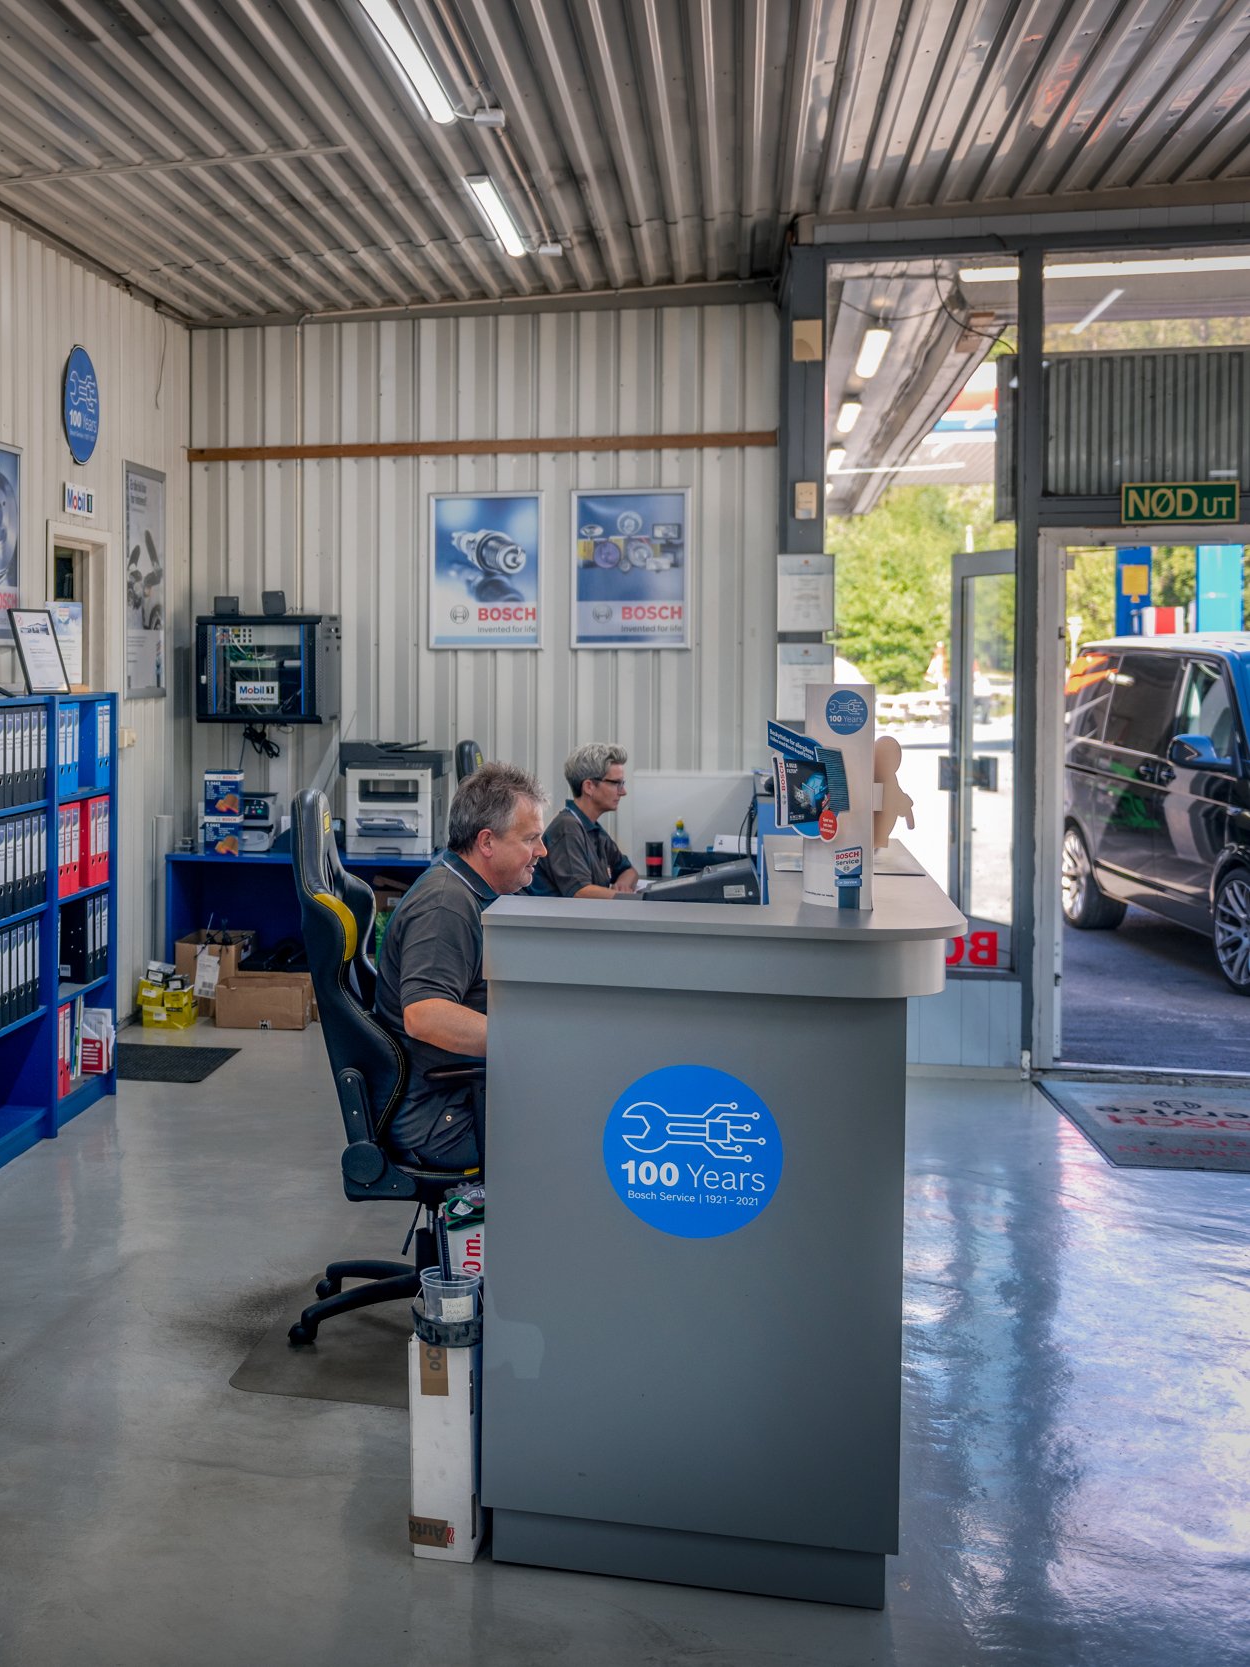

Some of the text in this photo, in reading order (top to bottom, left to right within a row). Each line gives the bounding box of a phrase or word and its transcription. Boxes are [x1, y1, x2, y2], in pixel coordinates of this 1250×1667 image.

[69, 408, 82, 428] 100
[67, 488, 86, 513] Mobil
[1128, 488, 1231, 519] NØD UT
[478, 607, 537, 621] BOSCH
[621, 606, 683, 620] BOSCH
[478, 625, 537, 633] Invented for life
[621, 624, 683, 633] Invented for life
[239, 686, 265, 694] Mobil
[835, 851, 860, 860] BOSCH
[1096, 1105, 1250, 1119] ervice
[1108, 1114, 1250, 1131] OSCH
[621, 1160, 766, 1192] 100 Years
[627, 1190, 758, 1206] Bosch Service 1921 2021
